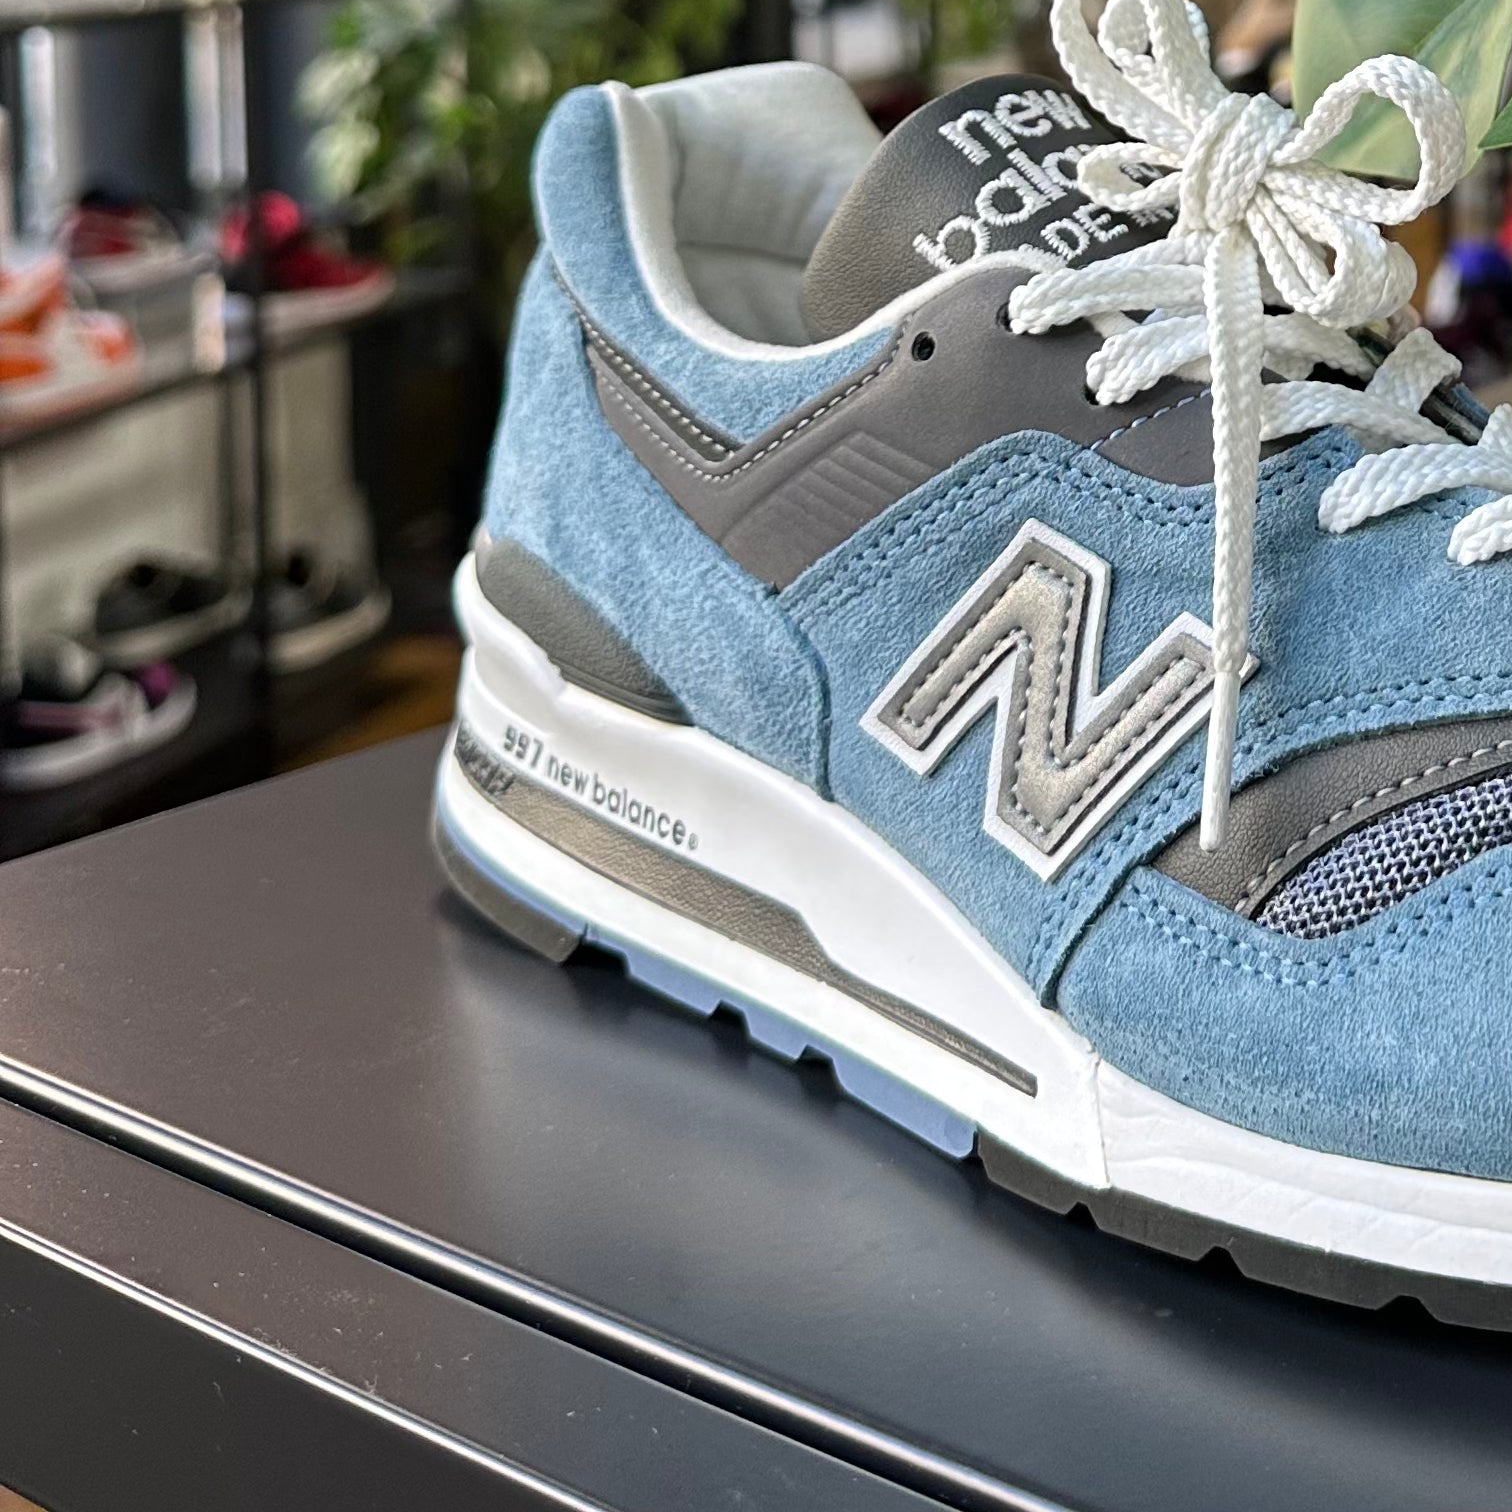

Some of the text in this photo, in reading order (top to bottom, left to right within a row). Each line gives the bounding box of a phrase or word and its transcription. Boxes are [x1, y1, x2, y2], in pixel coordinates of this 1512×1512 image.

[938, 89, 1092, 166] new
[911, 143, 1163, 272] bala
[1022, 201, 1129, 270] DE
[859, 516, 1261, 883] N
[503, 724, 544, 765] 997
[548, 754, 589, 792] new
